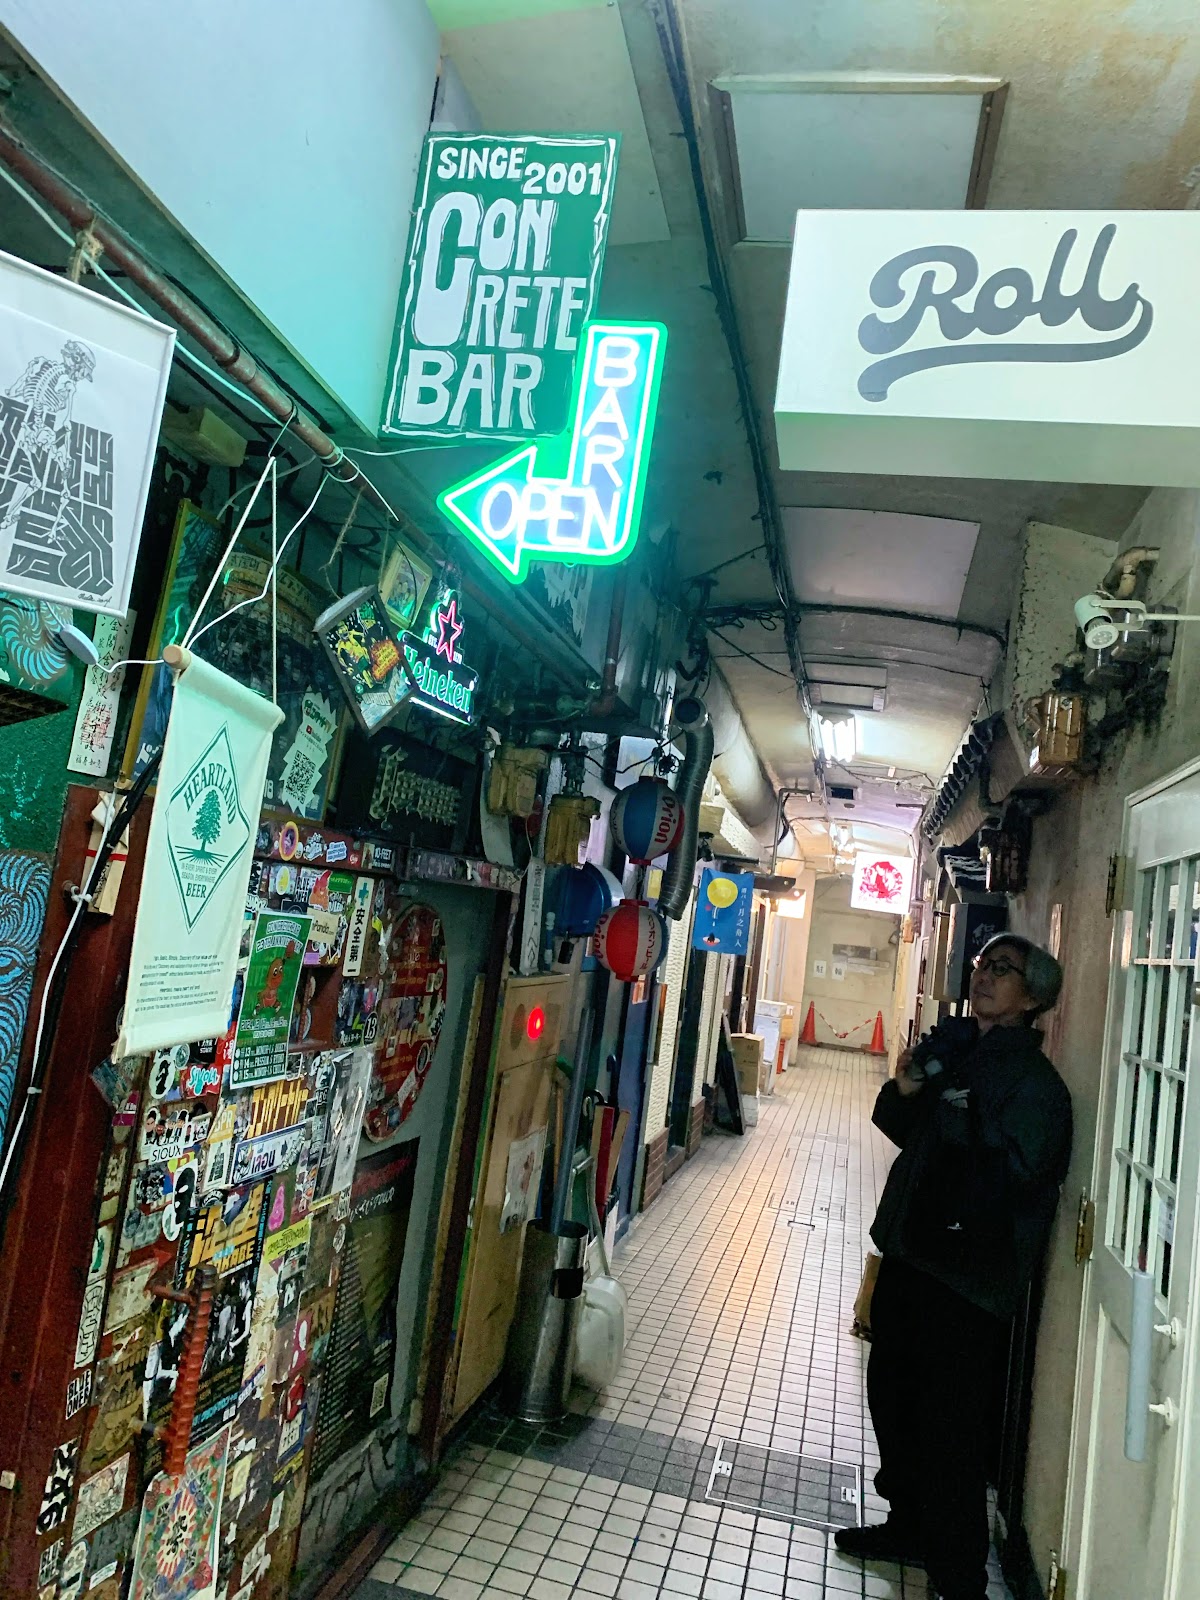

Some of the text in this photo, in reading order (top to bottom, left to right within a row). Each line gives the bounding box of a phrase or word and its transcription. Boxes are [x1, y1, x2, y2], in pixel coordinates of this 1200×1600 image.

[437, 146, 603, 196] SINCE 2001
[857, 223, 1153, 372] Roll
[399, 348, 543, 430] BAR
[582, 336, 637, 488] BAR
[481, 482, 620, 550] OPEN
[183, 762, 237, 825] HEARTLAND
[654, 795, 677, 844] Orion
[185, 882, 207, 899] BEER
[347, 907, 366, 973] 安全第一
[364, 1017, 378, 1040] 13
[153, 1146, 182, 1163] SIOUX
[68, 1370, 91, 1401] BLUE
